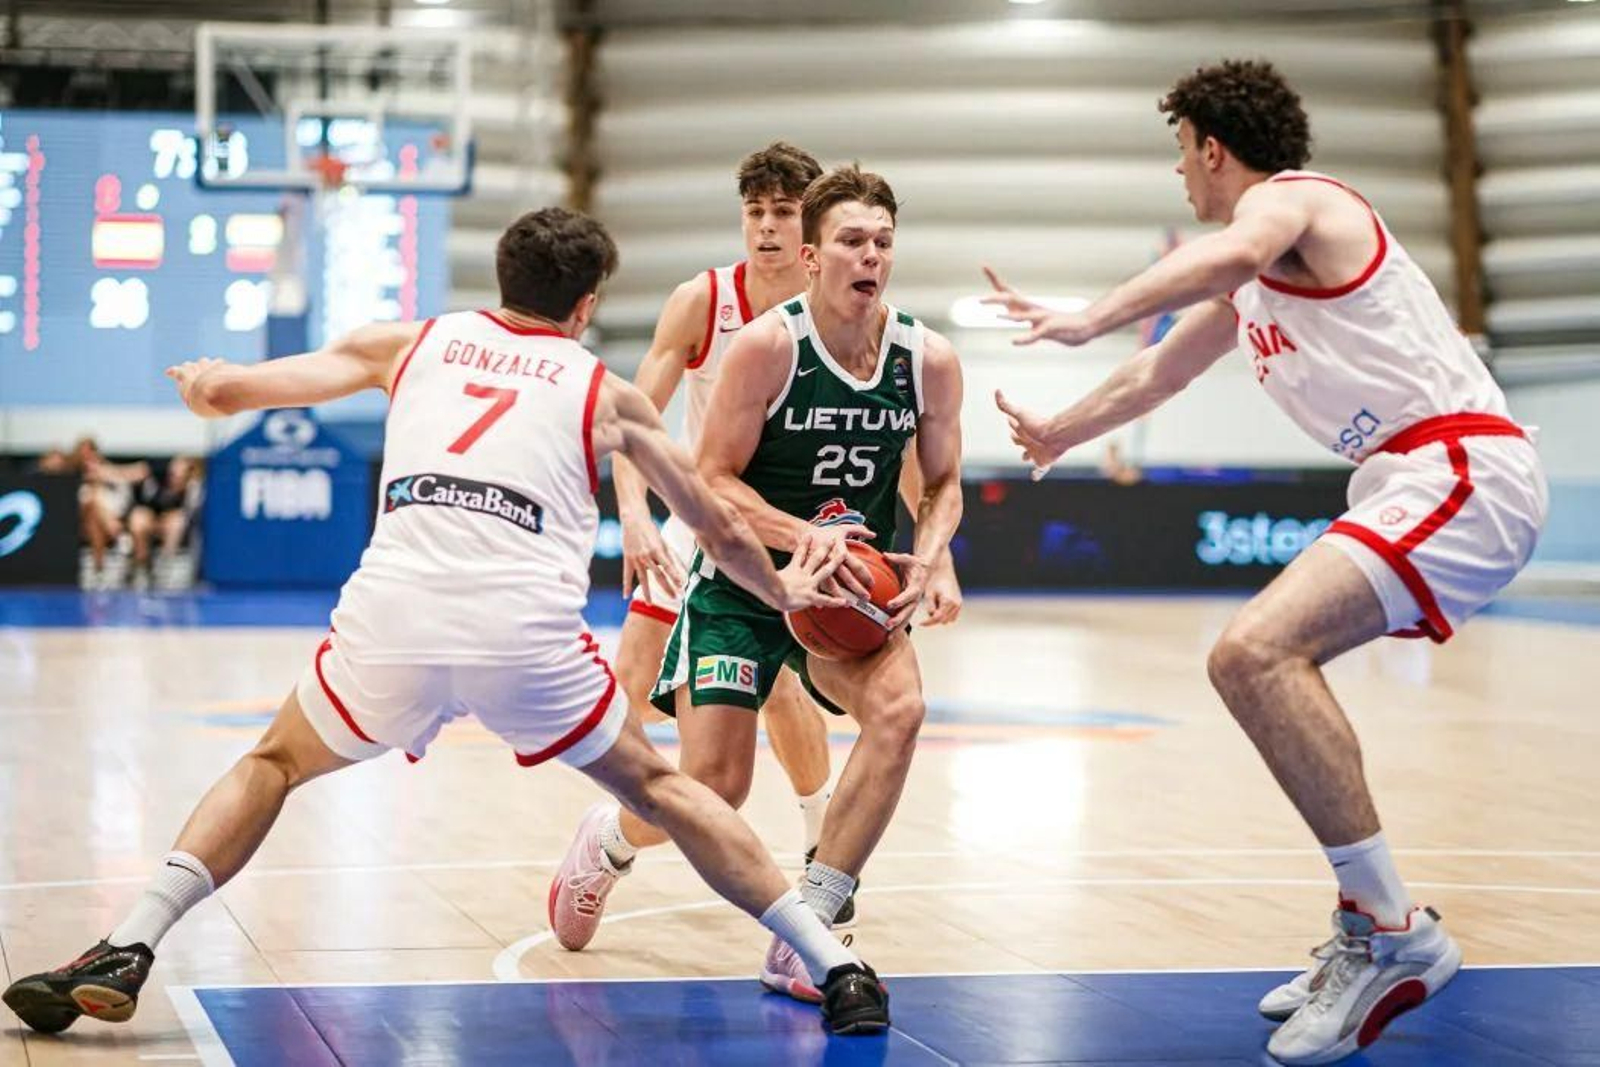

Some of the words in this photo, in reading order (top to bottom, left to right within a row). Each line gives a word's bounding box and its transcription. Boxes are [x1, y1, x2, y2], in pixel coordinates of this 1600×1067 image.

[443, 339, 566, 386] GONZALEZ
[446, 382, 519, 456] 7
[784, 406, 917, 432] LIETUVA
[812, 444, 881, 487] 25
[411, 475, 537, 530] CaixaBank
